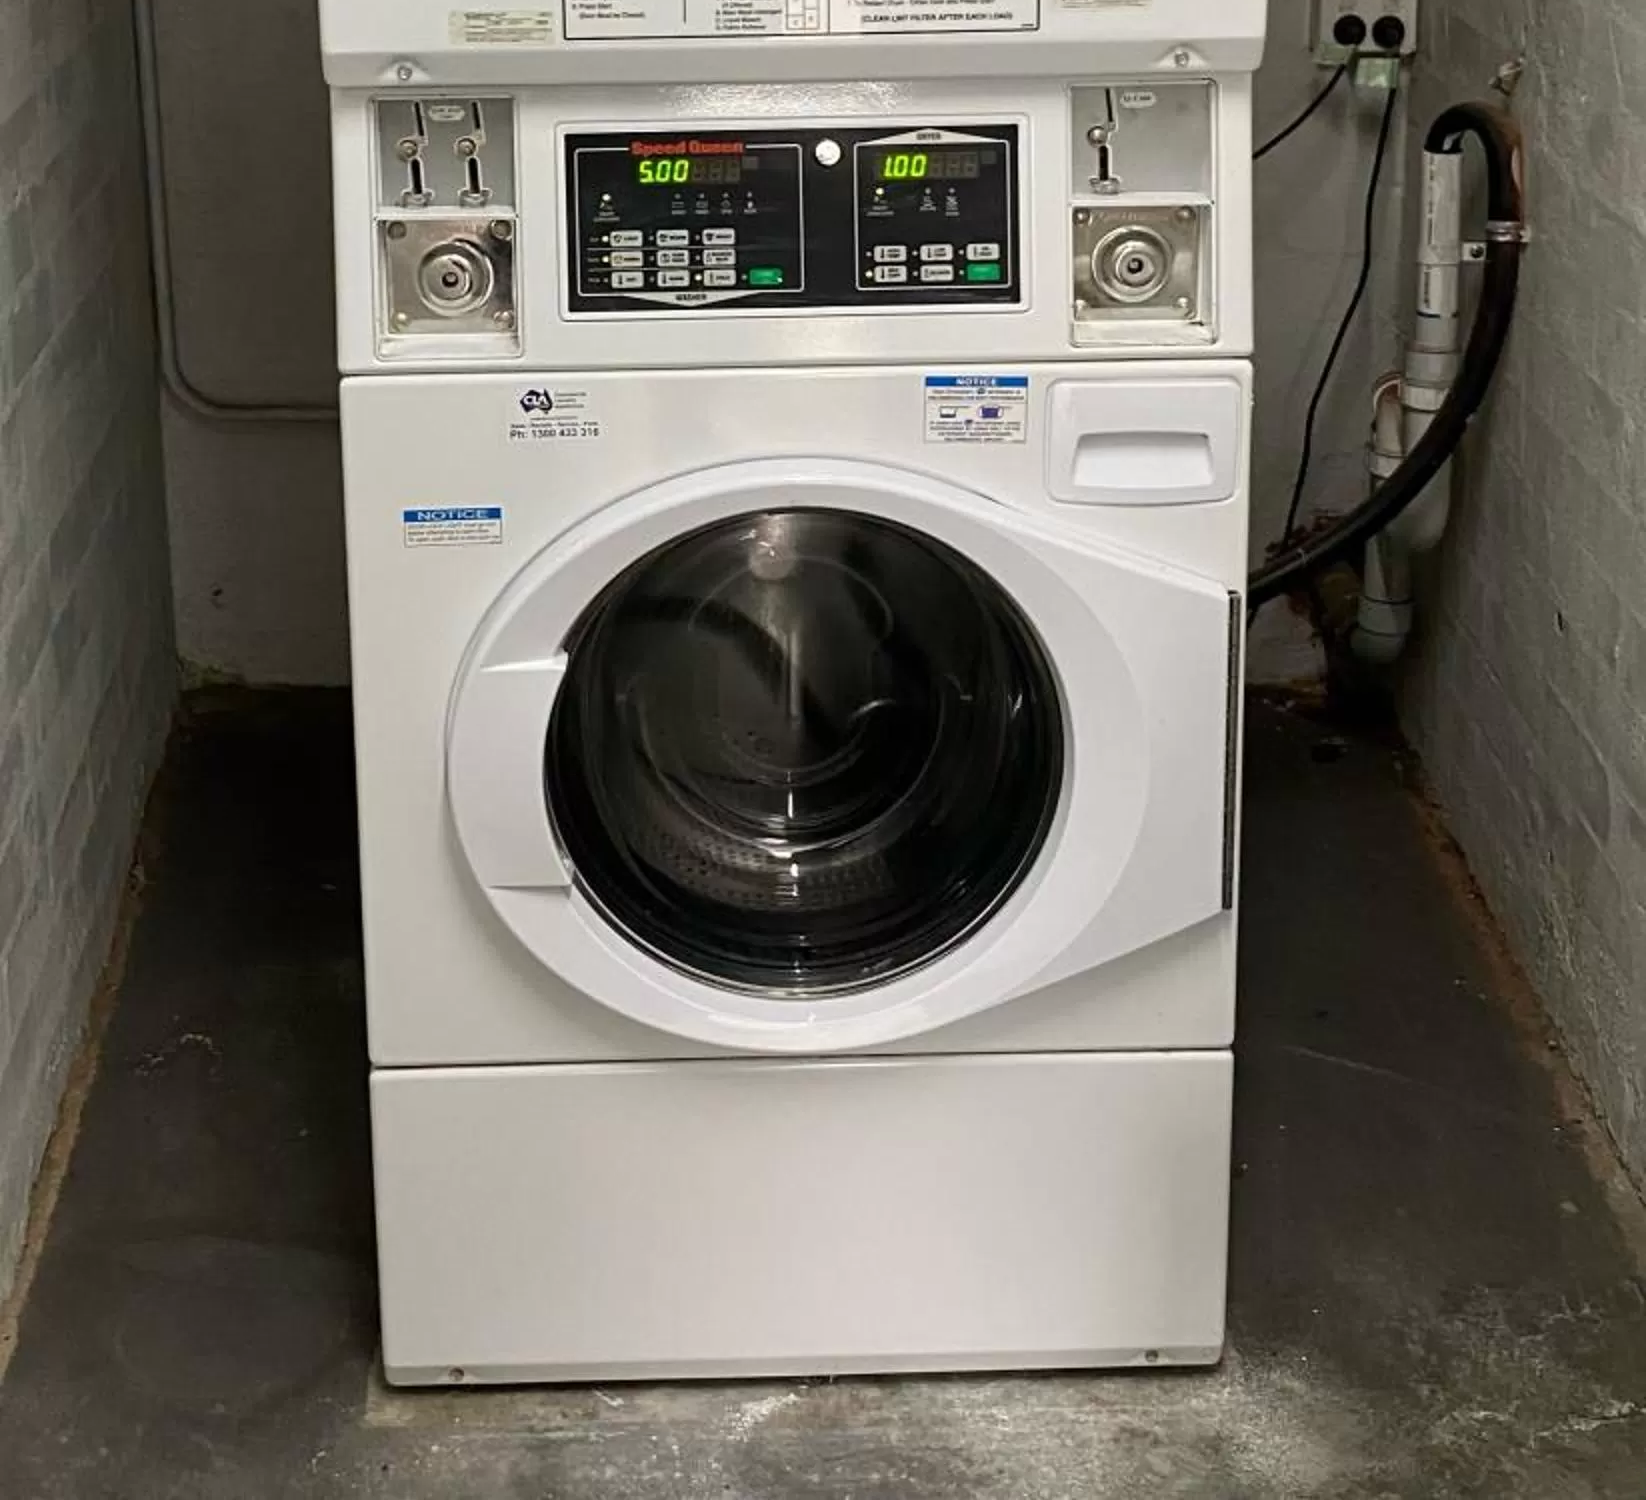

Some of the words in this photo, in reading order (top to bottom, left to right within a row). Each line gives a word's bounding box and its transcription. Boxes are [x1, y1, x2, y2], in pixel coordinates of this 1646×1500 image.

[631, 140, 686, 157] Speed
[688, 139, 744, 154] Queen
[417, 509, 489, 521] NOTICE
